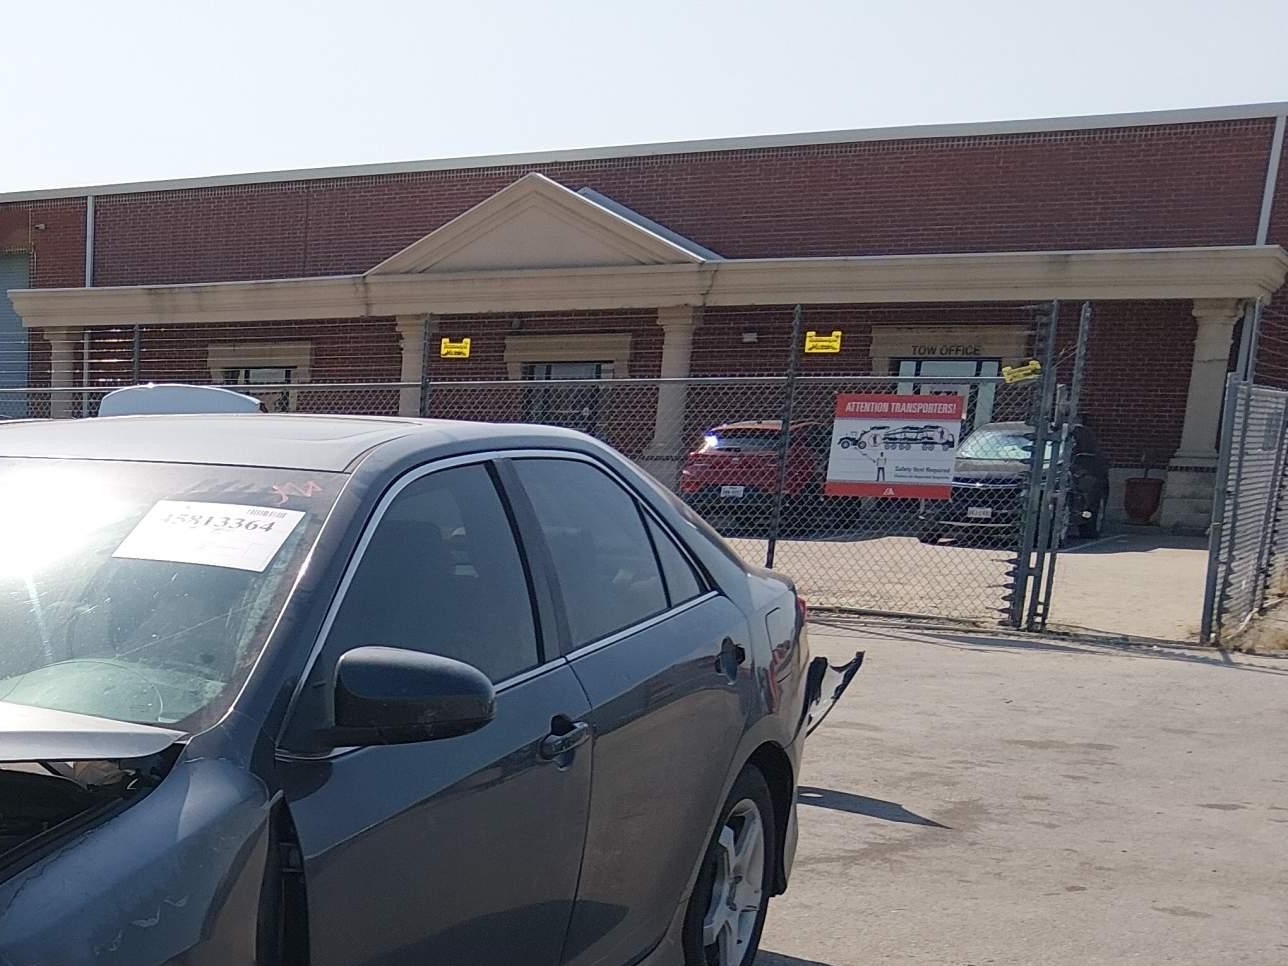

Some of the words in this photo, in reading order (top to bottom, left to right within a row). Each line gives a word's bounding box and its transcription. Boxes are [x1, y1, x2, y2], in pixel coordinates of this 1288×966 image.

[912, 345, 937, 355] TOW
[939, 345, 982, 355] OFFICE
[845, 401, 888, 413] ATTENTION
[890, 402, 956, 414] TRANSPORTERS!
